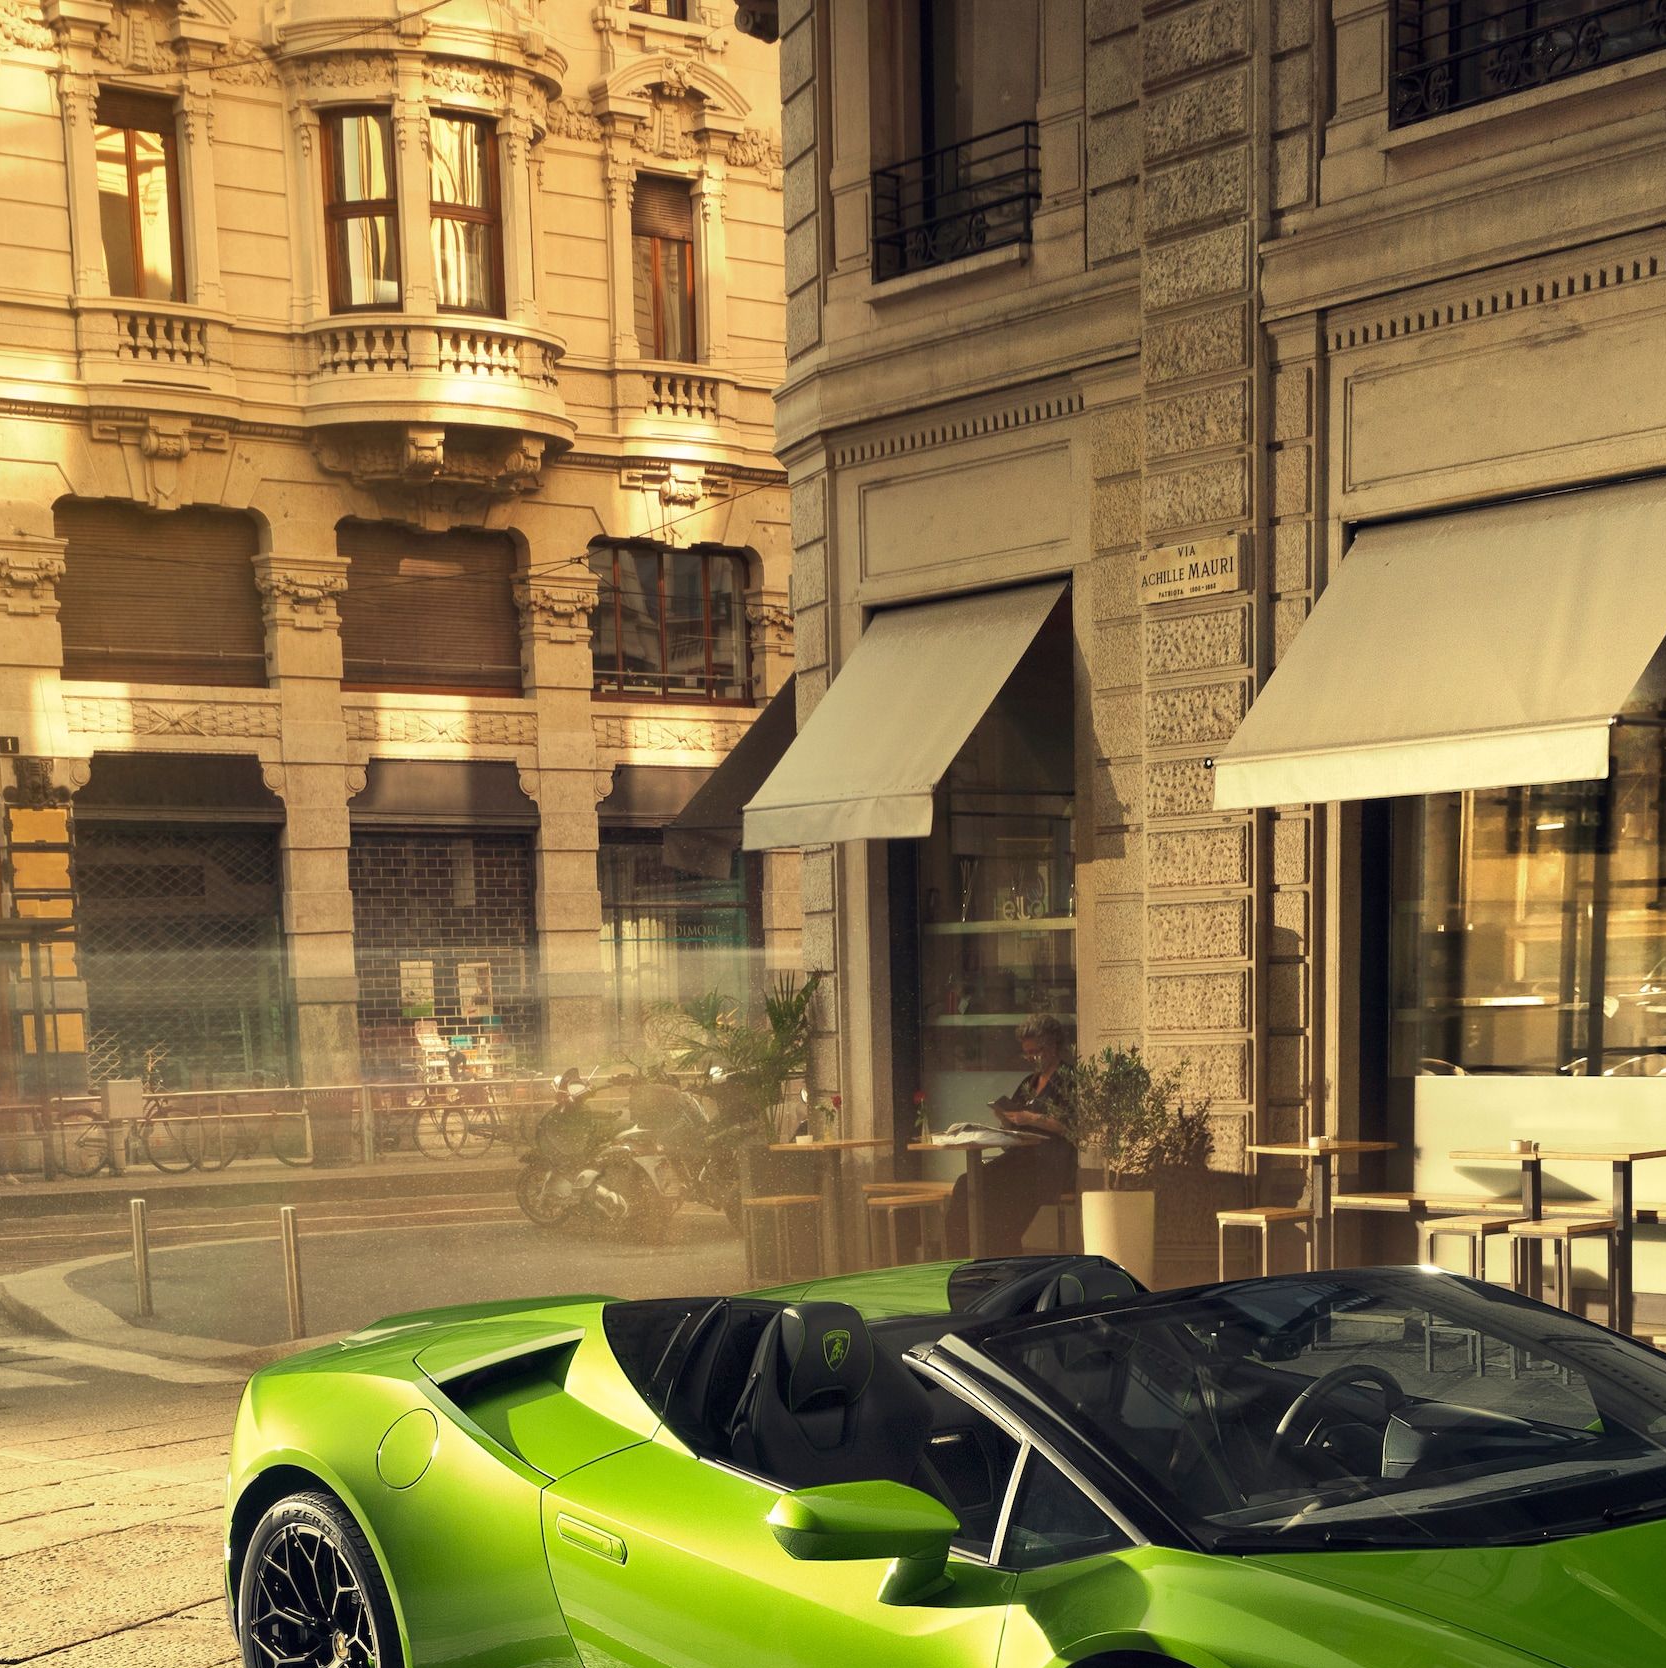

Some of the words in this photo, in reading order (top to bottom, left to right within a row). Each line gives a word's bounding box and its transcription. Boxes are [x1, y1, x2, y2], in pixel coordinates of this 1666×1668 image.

[1178, 545, 1196, 557] VIA
[1141, 567, 1185, 588] ACHILLE
[1188, 556, 1234, 580] MAURI
[1158, 589, 1184, 599] PATRIOTA
[6, 737, 13, 751] 1
[293, 1510, 333, 1536] ZERO
